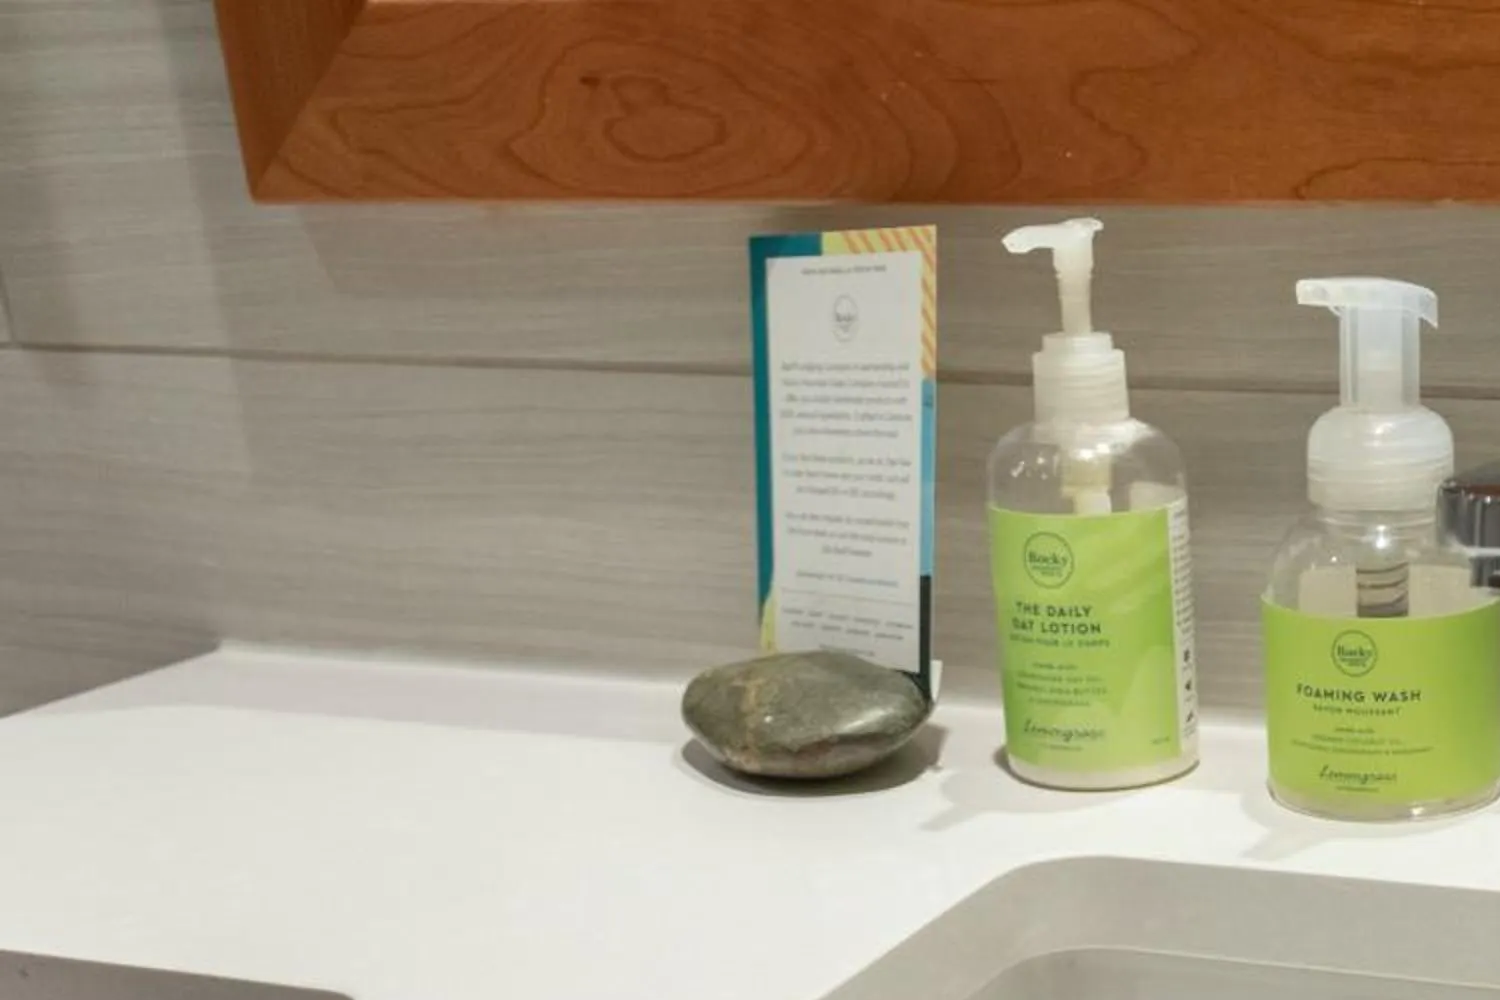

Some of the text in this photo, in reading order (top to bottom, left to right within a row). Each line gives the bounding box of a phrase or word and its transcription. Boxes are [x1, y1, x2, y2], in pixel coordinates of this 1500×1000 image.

[1028, 551, 1068, 566] Rocky
[1015, 601, 1092, 618] THE DAILY
[1041, 622, 1101, 635] LOTION
[1296, 683, 1422, 703] FOAMING WASH
